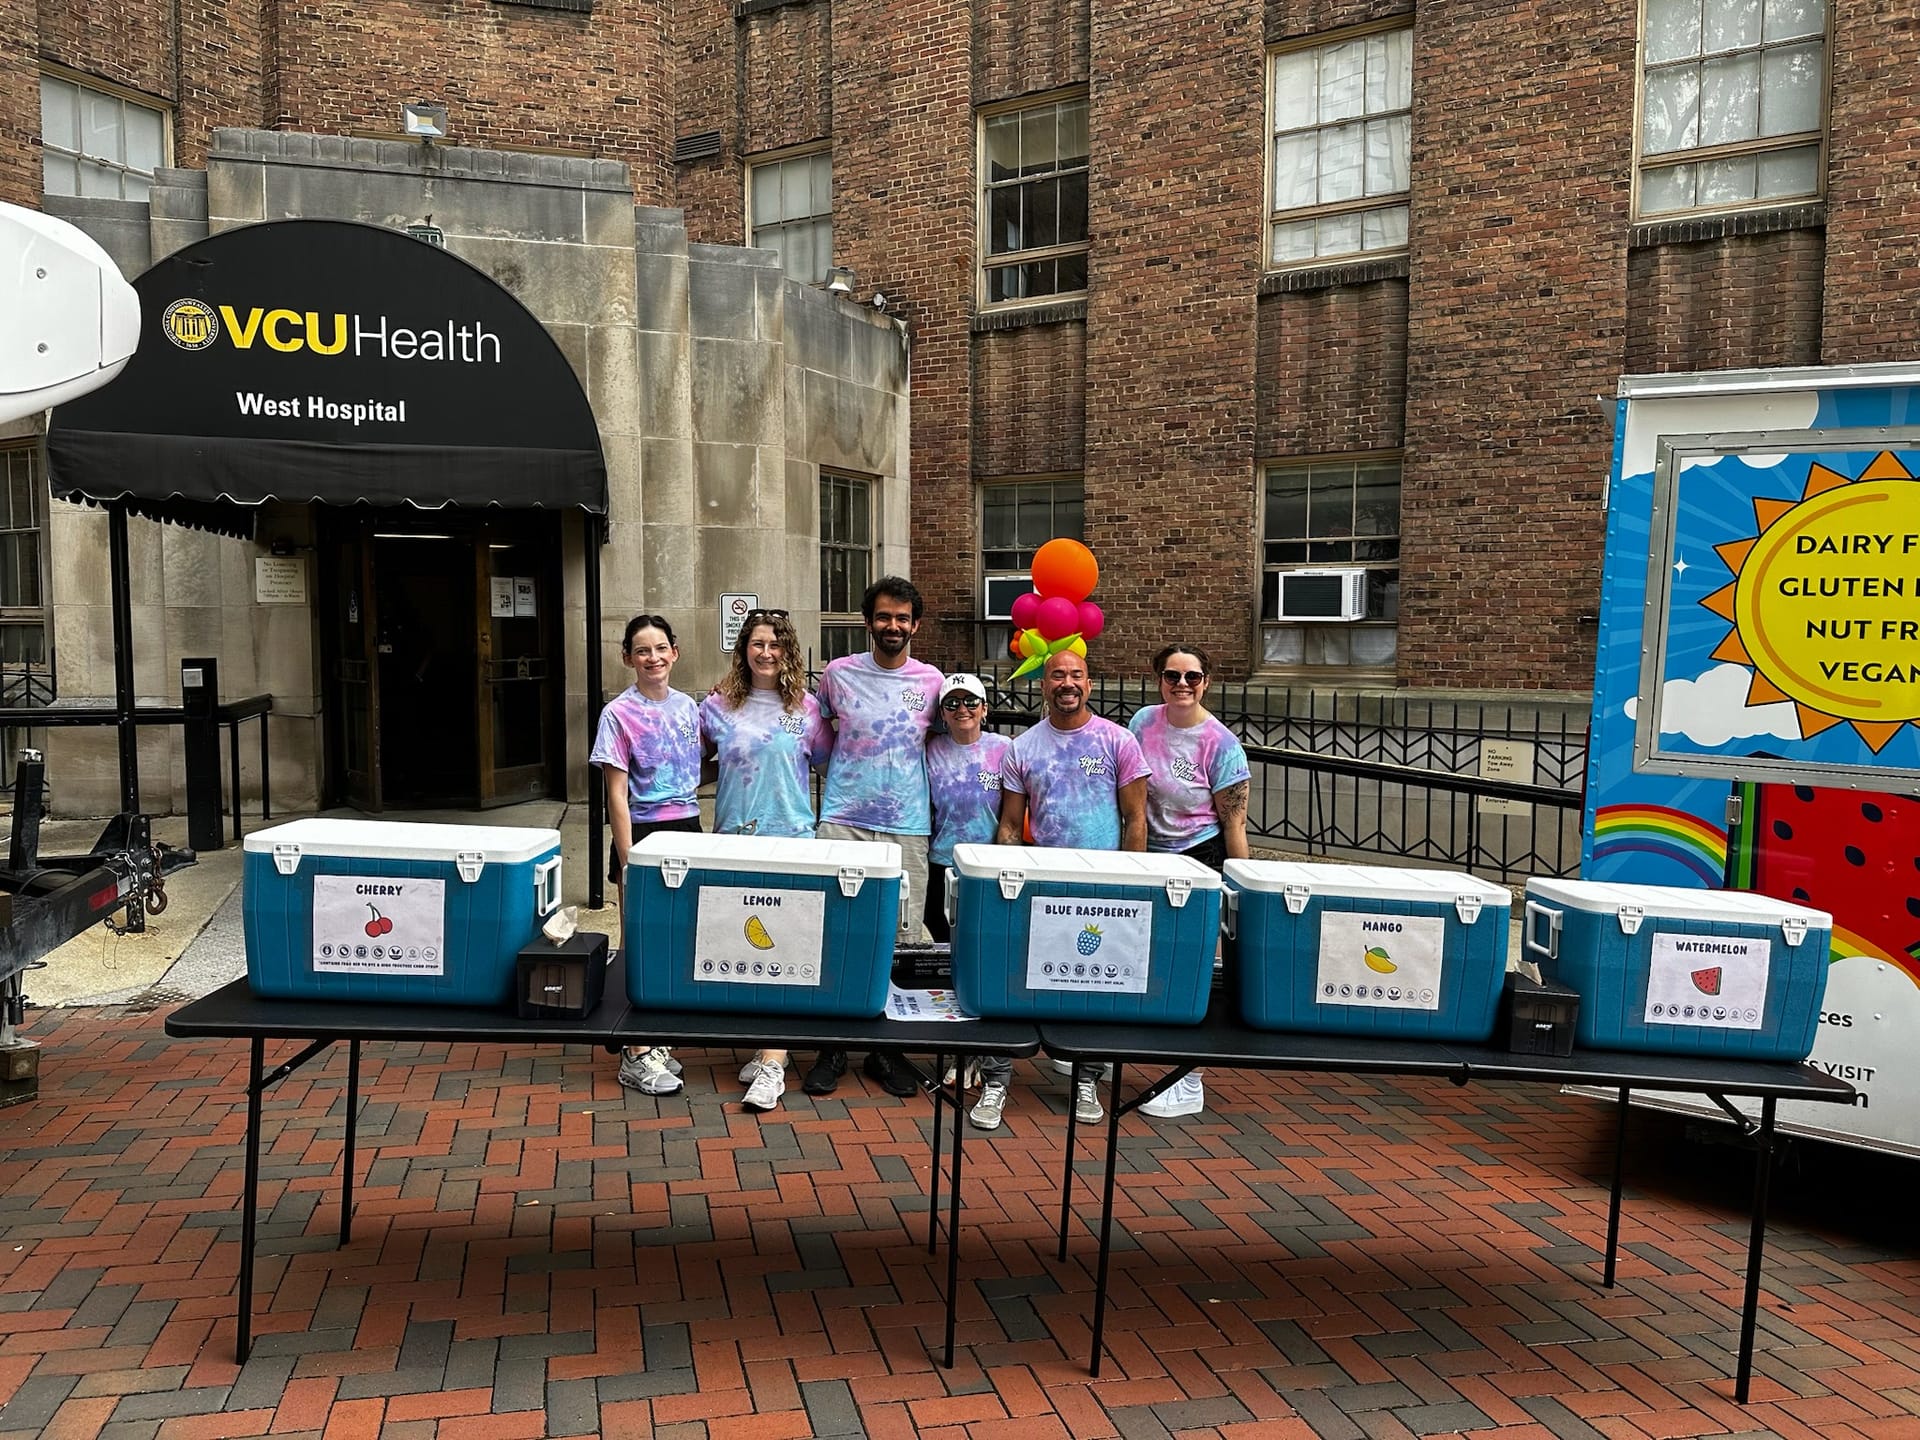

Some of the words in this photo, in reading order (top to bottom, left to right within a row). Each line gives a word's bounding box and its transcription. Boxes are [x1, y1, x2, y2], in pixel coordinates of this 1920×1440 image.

[218, 305, 348, 355] VCU
[354, 314, 501, 363] Health
[236, 392, 301, 418] West
[307, 395, 406, 426] Hospital
[1796, 534, 1894, 554] DAIRY
[1778, 577, 1904, 597] GLUTEN
[1806, 620, 1872, 639] NUT
[1881, 621, 1919, 640] FR
[356, 884, 403, 896] CHERRY
[743, 895, 781, 906] LEMON
[1045, 905, 1072, 915] BLUE
[1076, 906, 1139, 918] RASPBERRY
[1362, 921, 1403, 932] MANGO
[1675, 941, 1747, 955] WATERMELON
[1818, 1011, 1853, 1028] ces
[1824, 1062, 1875, 1081] VISIT
